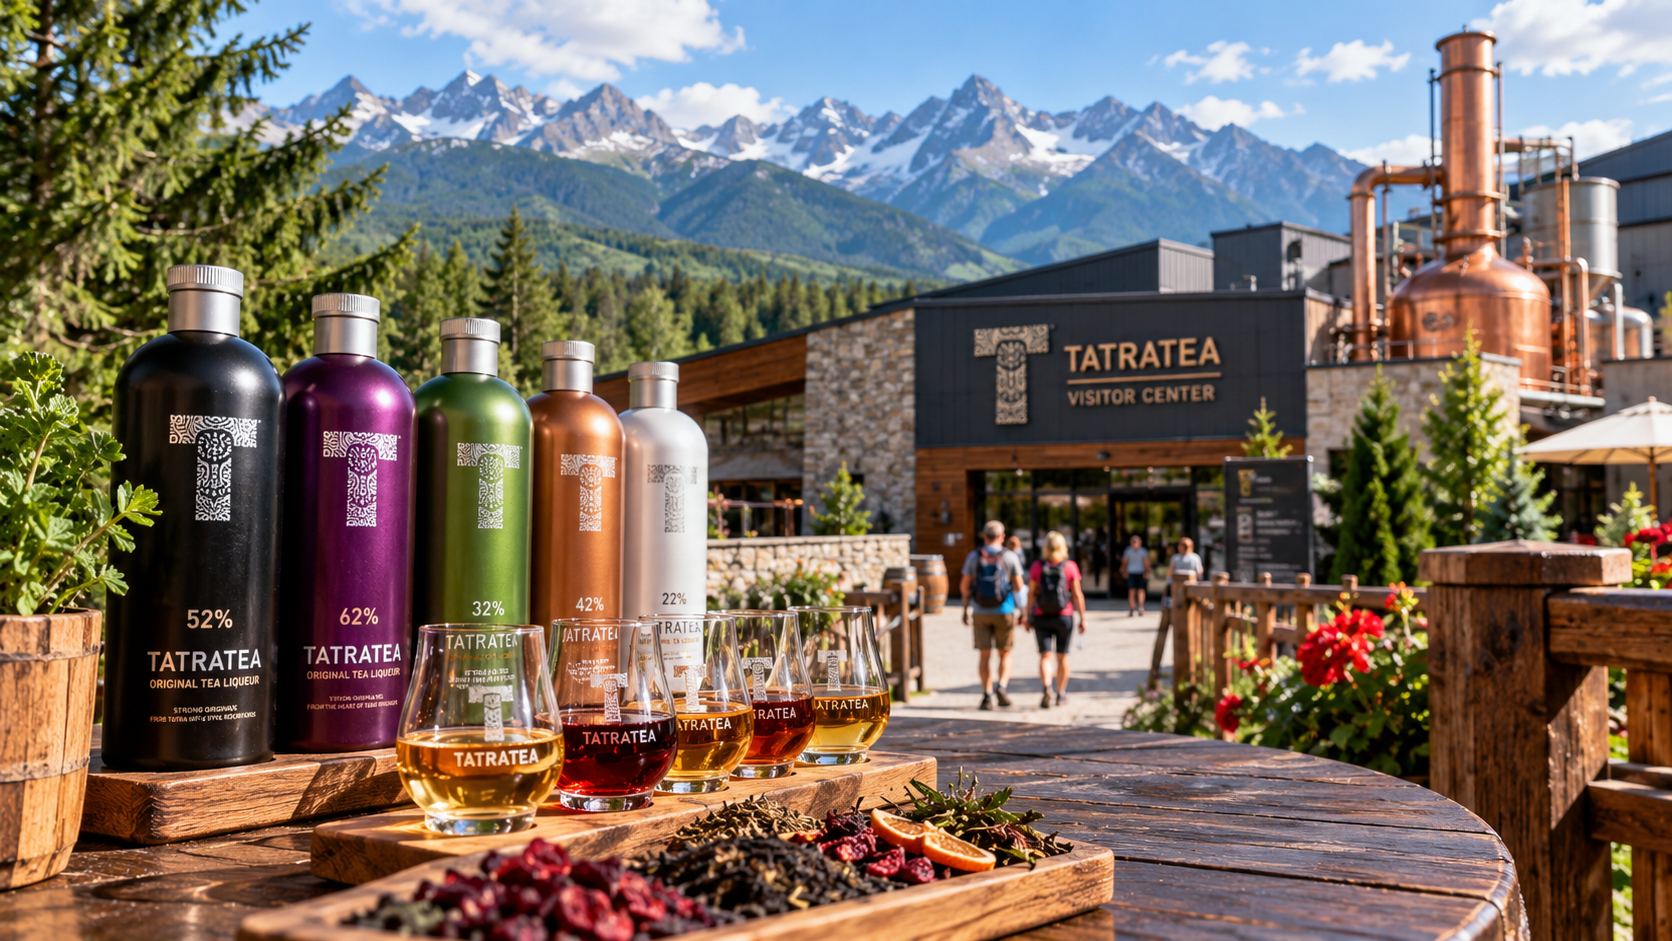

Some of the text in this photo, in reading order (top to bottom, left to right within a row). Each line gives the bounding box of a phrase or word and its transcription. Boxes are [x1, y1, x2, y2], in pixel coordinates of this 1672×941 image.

[1063, 336, 1222, 373] TATRATEA
[1067, 384, 1215, 406] VISITOR CENTER
[575, 597, 604, 612] 42%
[662, 592, 687, 606] 22%
[339, 607, 379, 626] 62%
[472, 601, 505, 617] 32%
[186, 608, 233, 630] 52%
[658, 620, 702, 635] TRATEA
[446, 633, 518, 650] TATRATEA
[147, 648, 262, 672] TATRATEA
[303, 643, 401, 665] TATRATEA
[306, 667, 401, 680] ORIGINAL TEA LIQUEUR
[149, 675, 260, 689] ORIGINAL TEA LIQUEUR
[816, 698, 869, 711] ATRATEA
[582, 729, 657, 745] TATRATEA
[454, 747, 540, 767] TATRATEA
